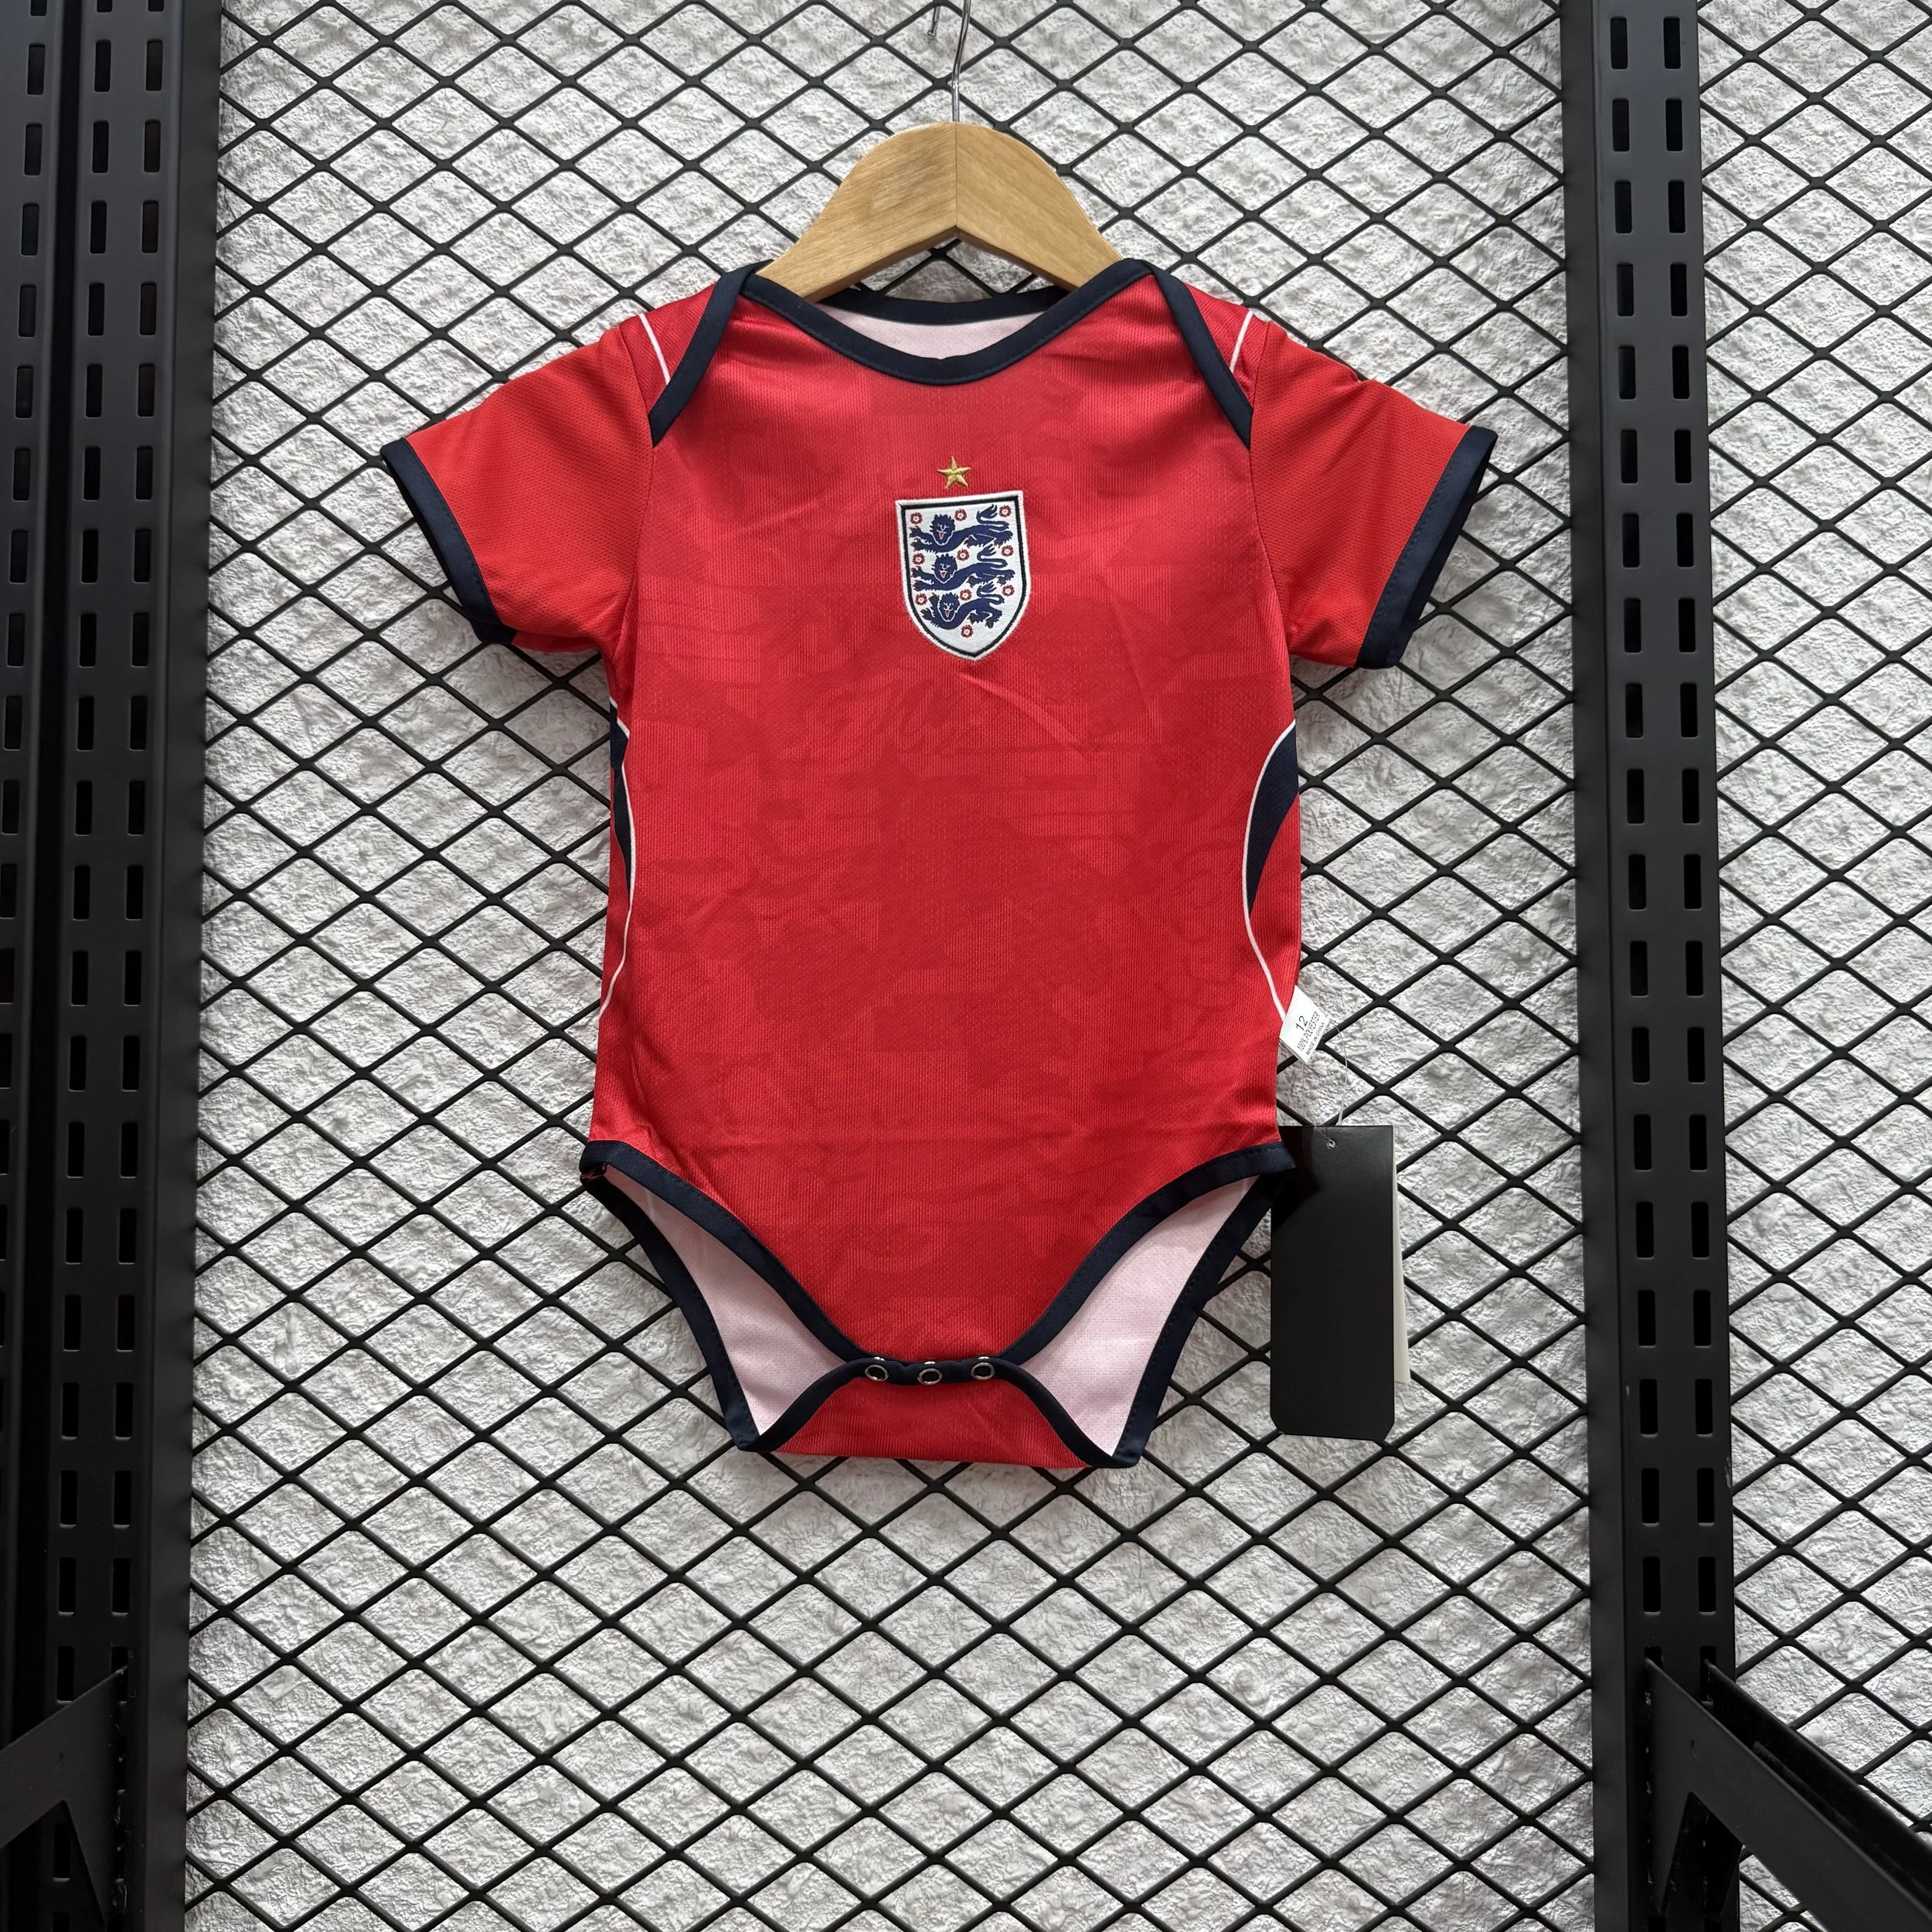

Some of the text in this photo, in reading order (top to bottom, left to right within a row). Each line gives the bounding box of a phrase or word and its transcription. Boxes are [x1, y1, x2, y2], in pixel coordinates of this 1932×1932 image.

[1295, 1015, 1308, 1031] 12
[1297, 1011, 1321, 1052] 100% POLYESTER
[1306, 1041, 1315, 1055] MADE
[1315, 1022, 1325, 1036] CHINA
